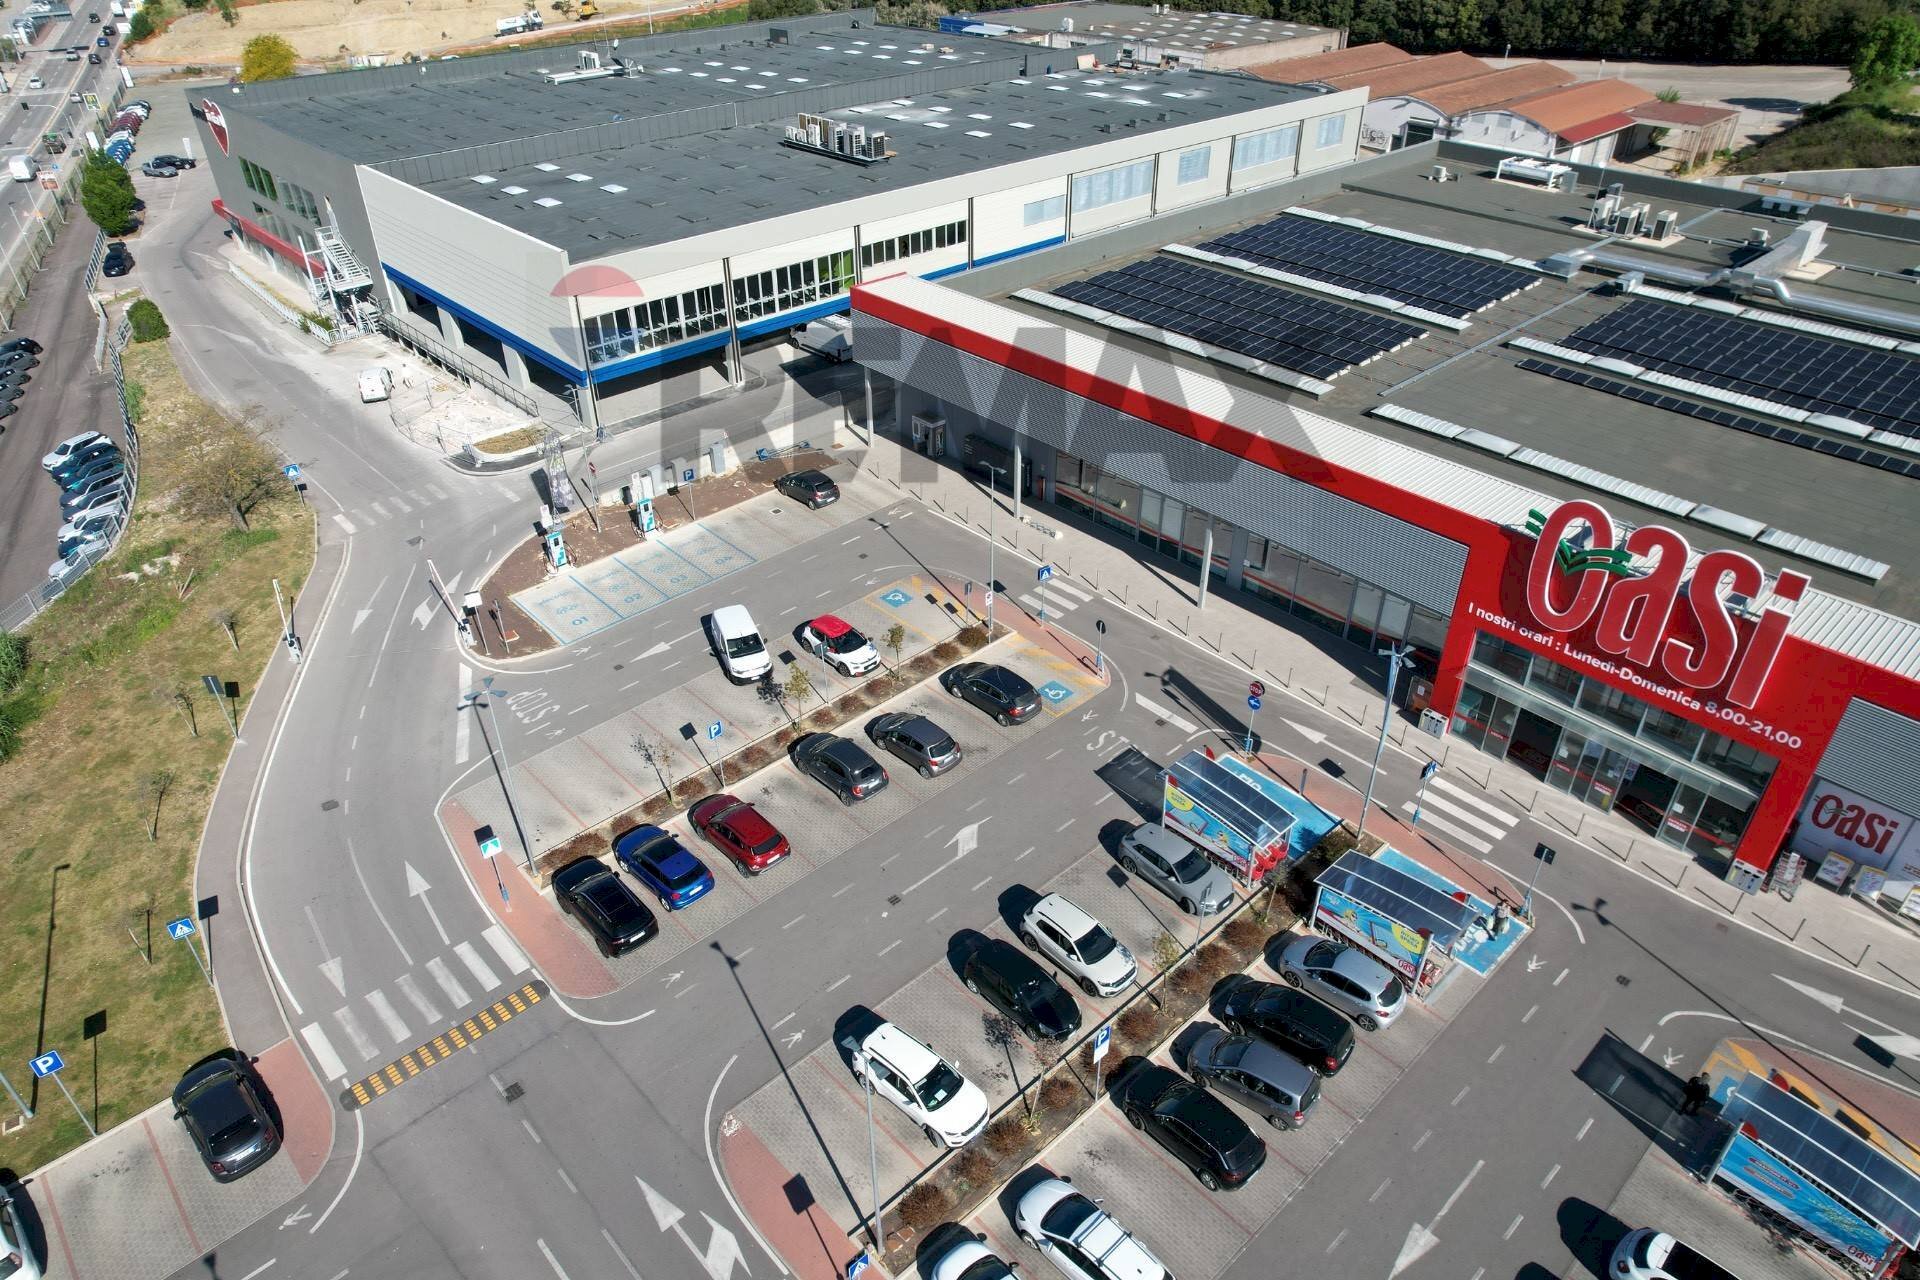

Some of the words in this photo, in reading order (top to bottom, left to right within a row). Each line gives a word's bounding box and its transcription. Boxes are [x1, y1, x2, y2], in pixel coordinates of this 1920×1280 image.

[1527, 499, 1811, 709] Oasi
[506, 688, 560, 724] STOP
[1468, 602, 1474, 614] I
[1476, 607, 1517, 632] nostri
[1519, 626, 1553, 648] orari
[1704, 700, 1802, 749] 8,00-21,00
[1811, 794, 1899, 855] Oasi
[35, 1056, 54, 1074] P
